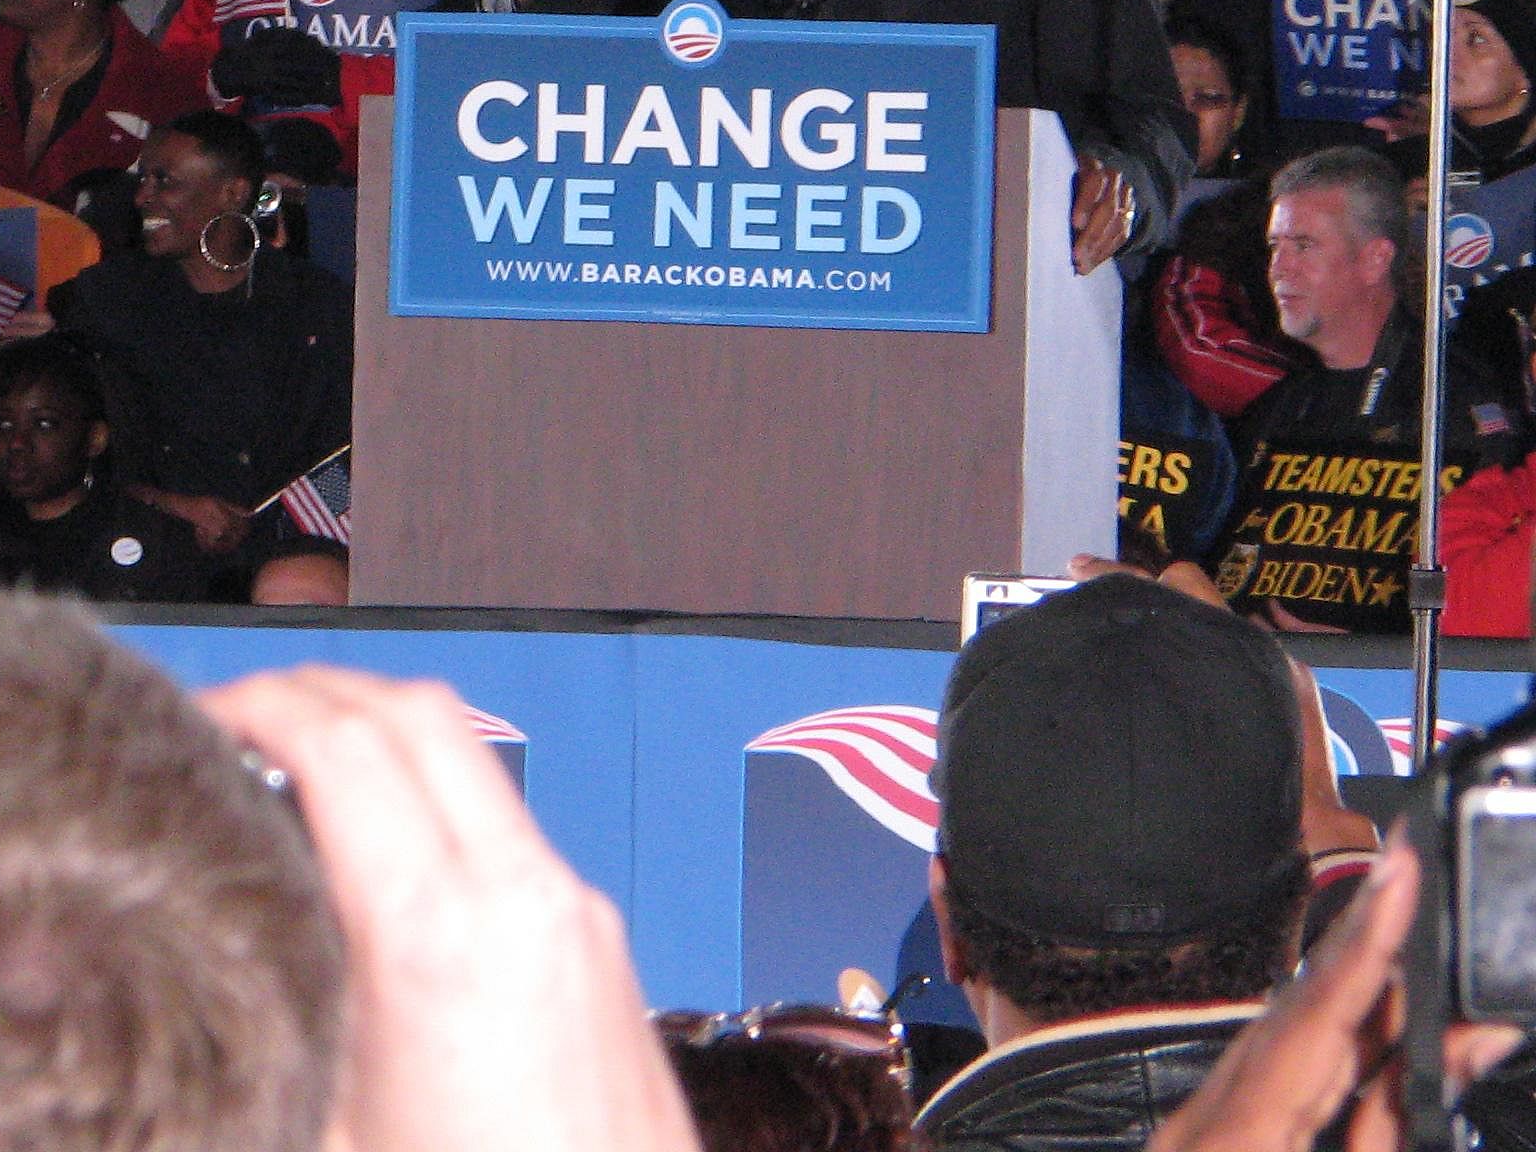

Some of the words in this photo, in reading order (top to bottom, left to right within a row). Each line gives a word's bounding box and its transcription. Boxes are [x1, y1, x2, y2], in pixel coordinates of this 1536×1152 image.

[1287, 31, 1369, 70] WE
[457, 80, 929, 173] CHANGE
[457, 174, 616, 246] WE
[653, 180, 923, 255] NEED
[486, 259, 892, 292] WWW.BARACKOBAMA.COM
[1264, 453, 1465, 502] TEAMSTES
[1249, 560, 1378, 604] BIDEN
